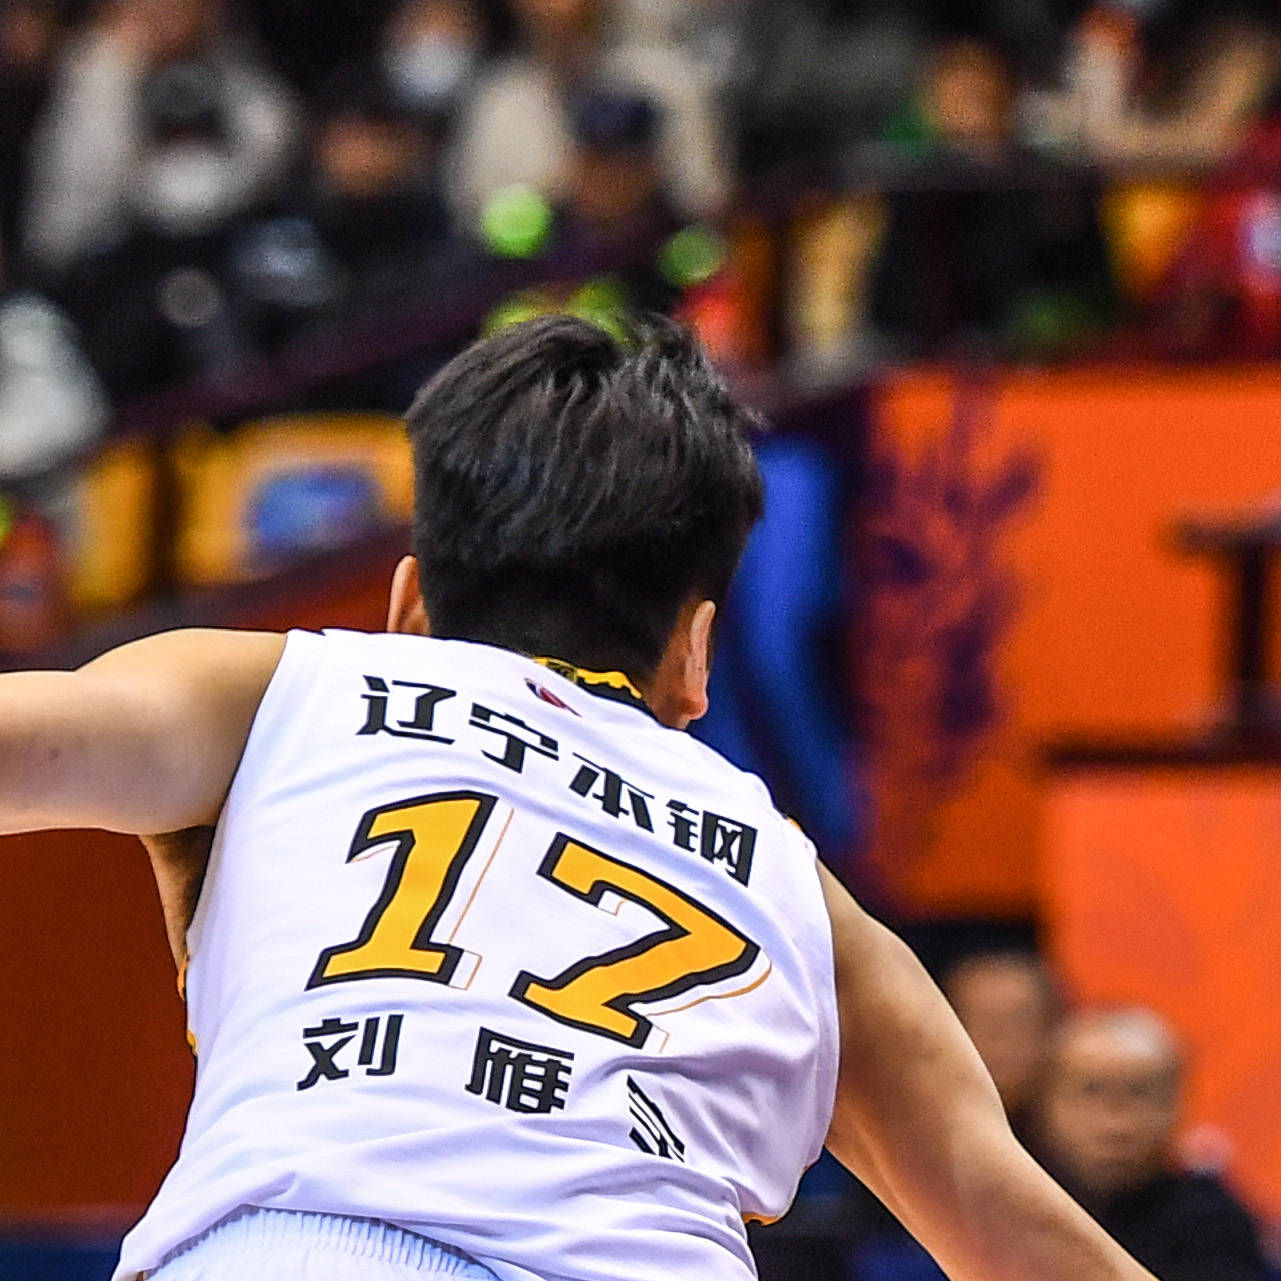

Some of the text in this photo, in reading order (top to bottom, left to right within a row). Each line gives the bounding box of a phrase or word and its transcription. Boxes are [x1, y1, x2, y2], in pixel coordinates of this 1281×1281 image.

[355, 674, 759, 888] 辽宁本钢
[304, 790, 761, 1050] 17
